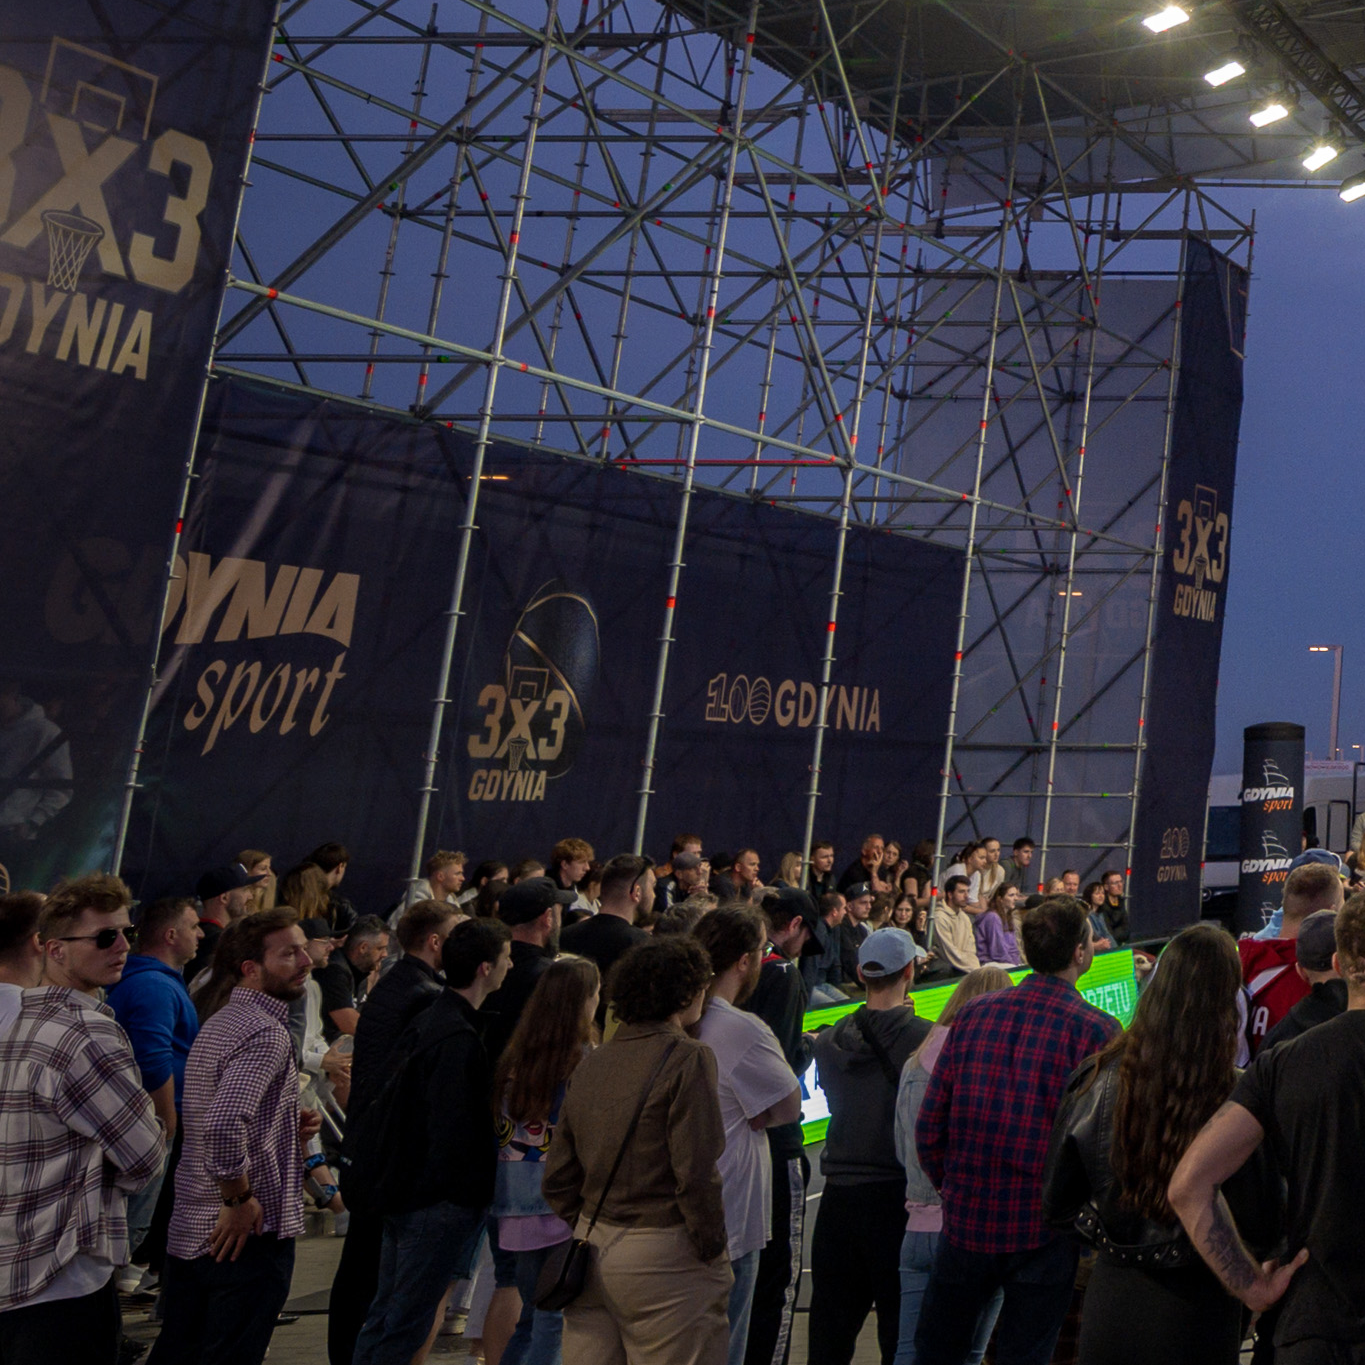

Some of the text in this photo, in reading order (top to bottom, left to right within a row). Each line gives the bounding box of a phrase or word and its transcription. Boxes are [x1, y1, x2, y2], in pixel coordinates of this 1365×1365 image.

[1173, 583, 1216, 622] GDYNIA
[183, 649, 347, 757] sport
[774, 679, 881, 733] GDYNIA
[467, 684, 570, 761] 3X3
[468, 769, 547, 801] GDYNIA
[1243, 787, 1295, 802] GDYNIA
[1263, 799, 1293, 813] sport
[1262, 874, 1288, 886] spor
